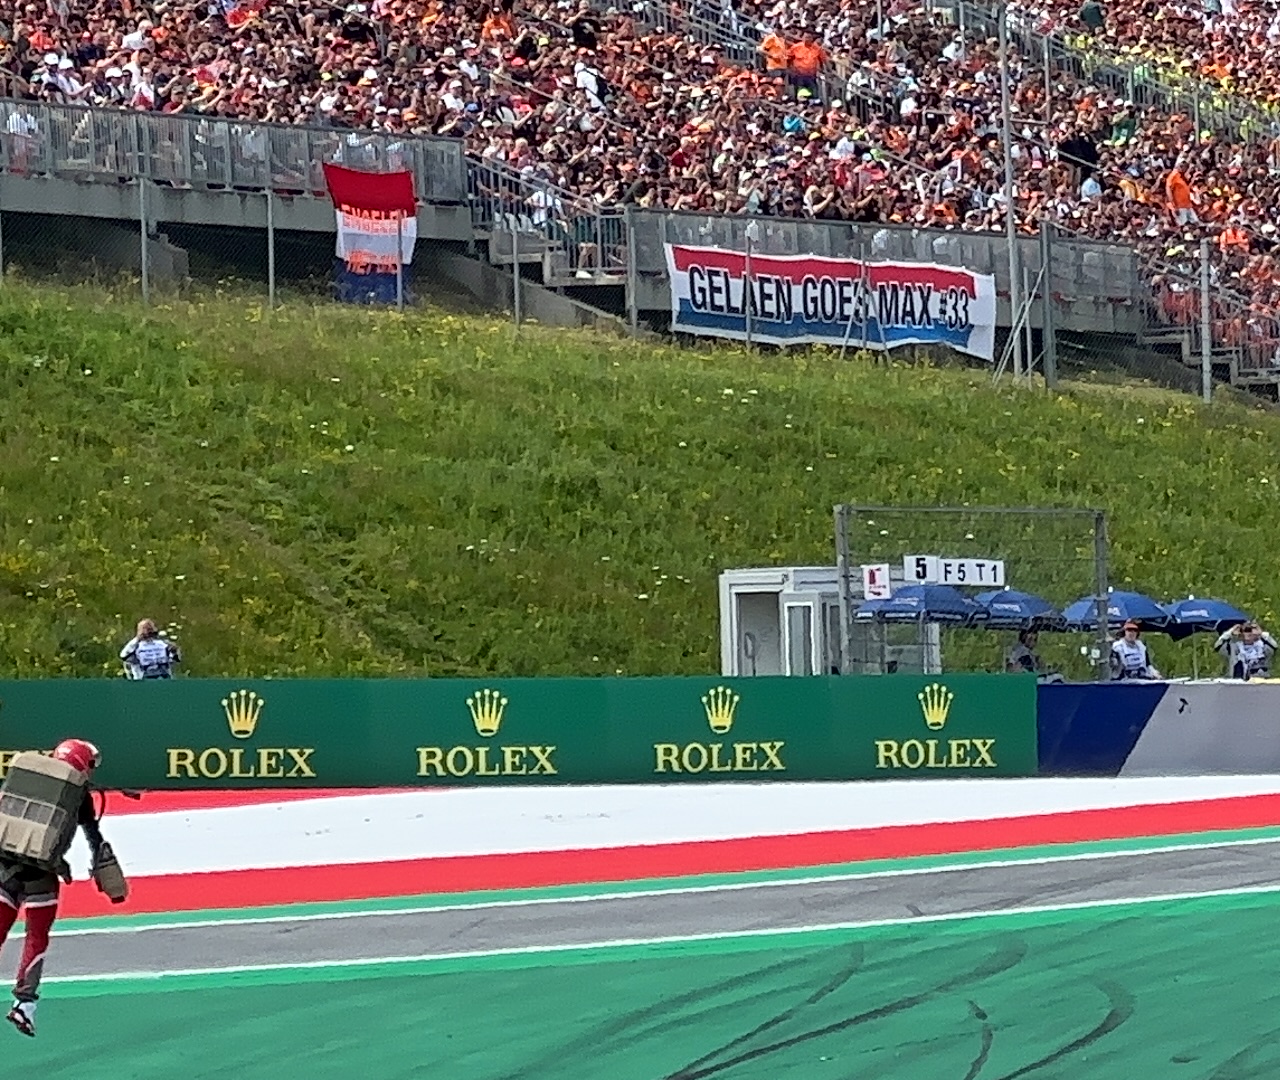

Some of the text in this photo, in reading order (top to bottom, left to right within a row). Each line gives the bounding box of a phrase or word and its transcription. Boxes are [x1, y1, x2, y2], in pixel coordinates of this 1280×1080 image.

[878, 283, 932, 326] MAX
[939, 286, 970, 331] #33
[915, 557, 927, 580] 5
[166, 747, 316, 778] ROLEX
[416, 745, 558, 777] ROLEX
[653, 741, 786, 773] ROLEX
[874, 738, 997, 769] ROLEX
